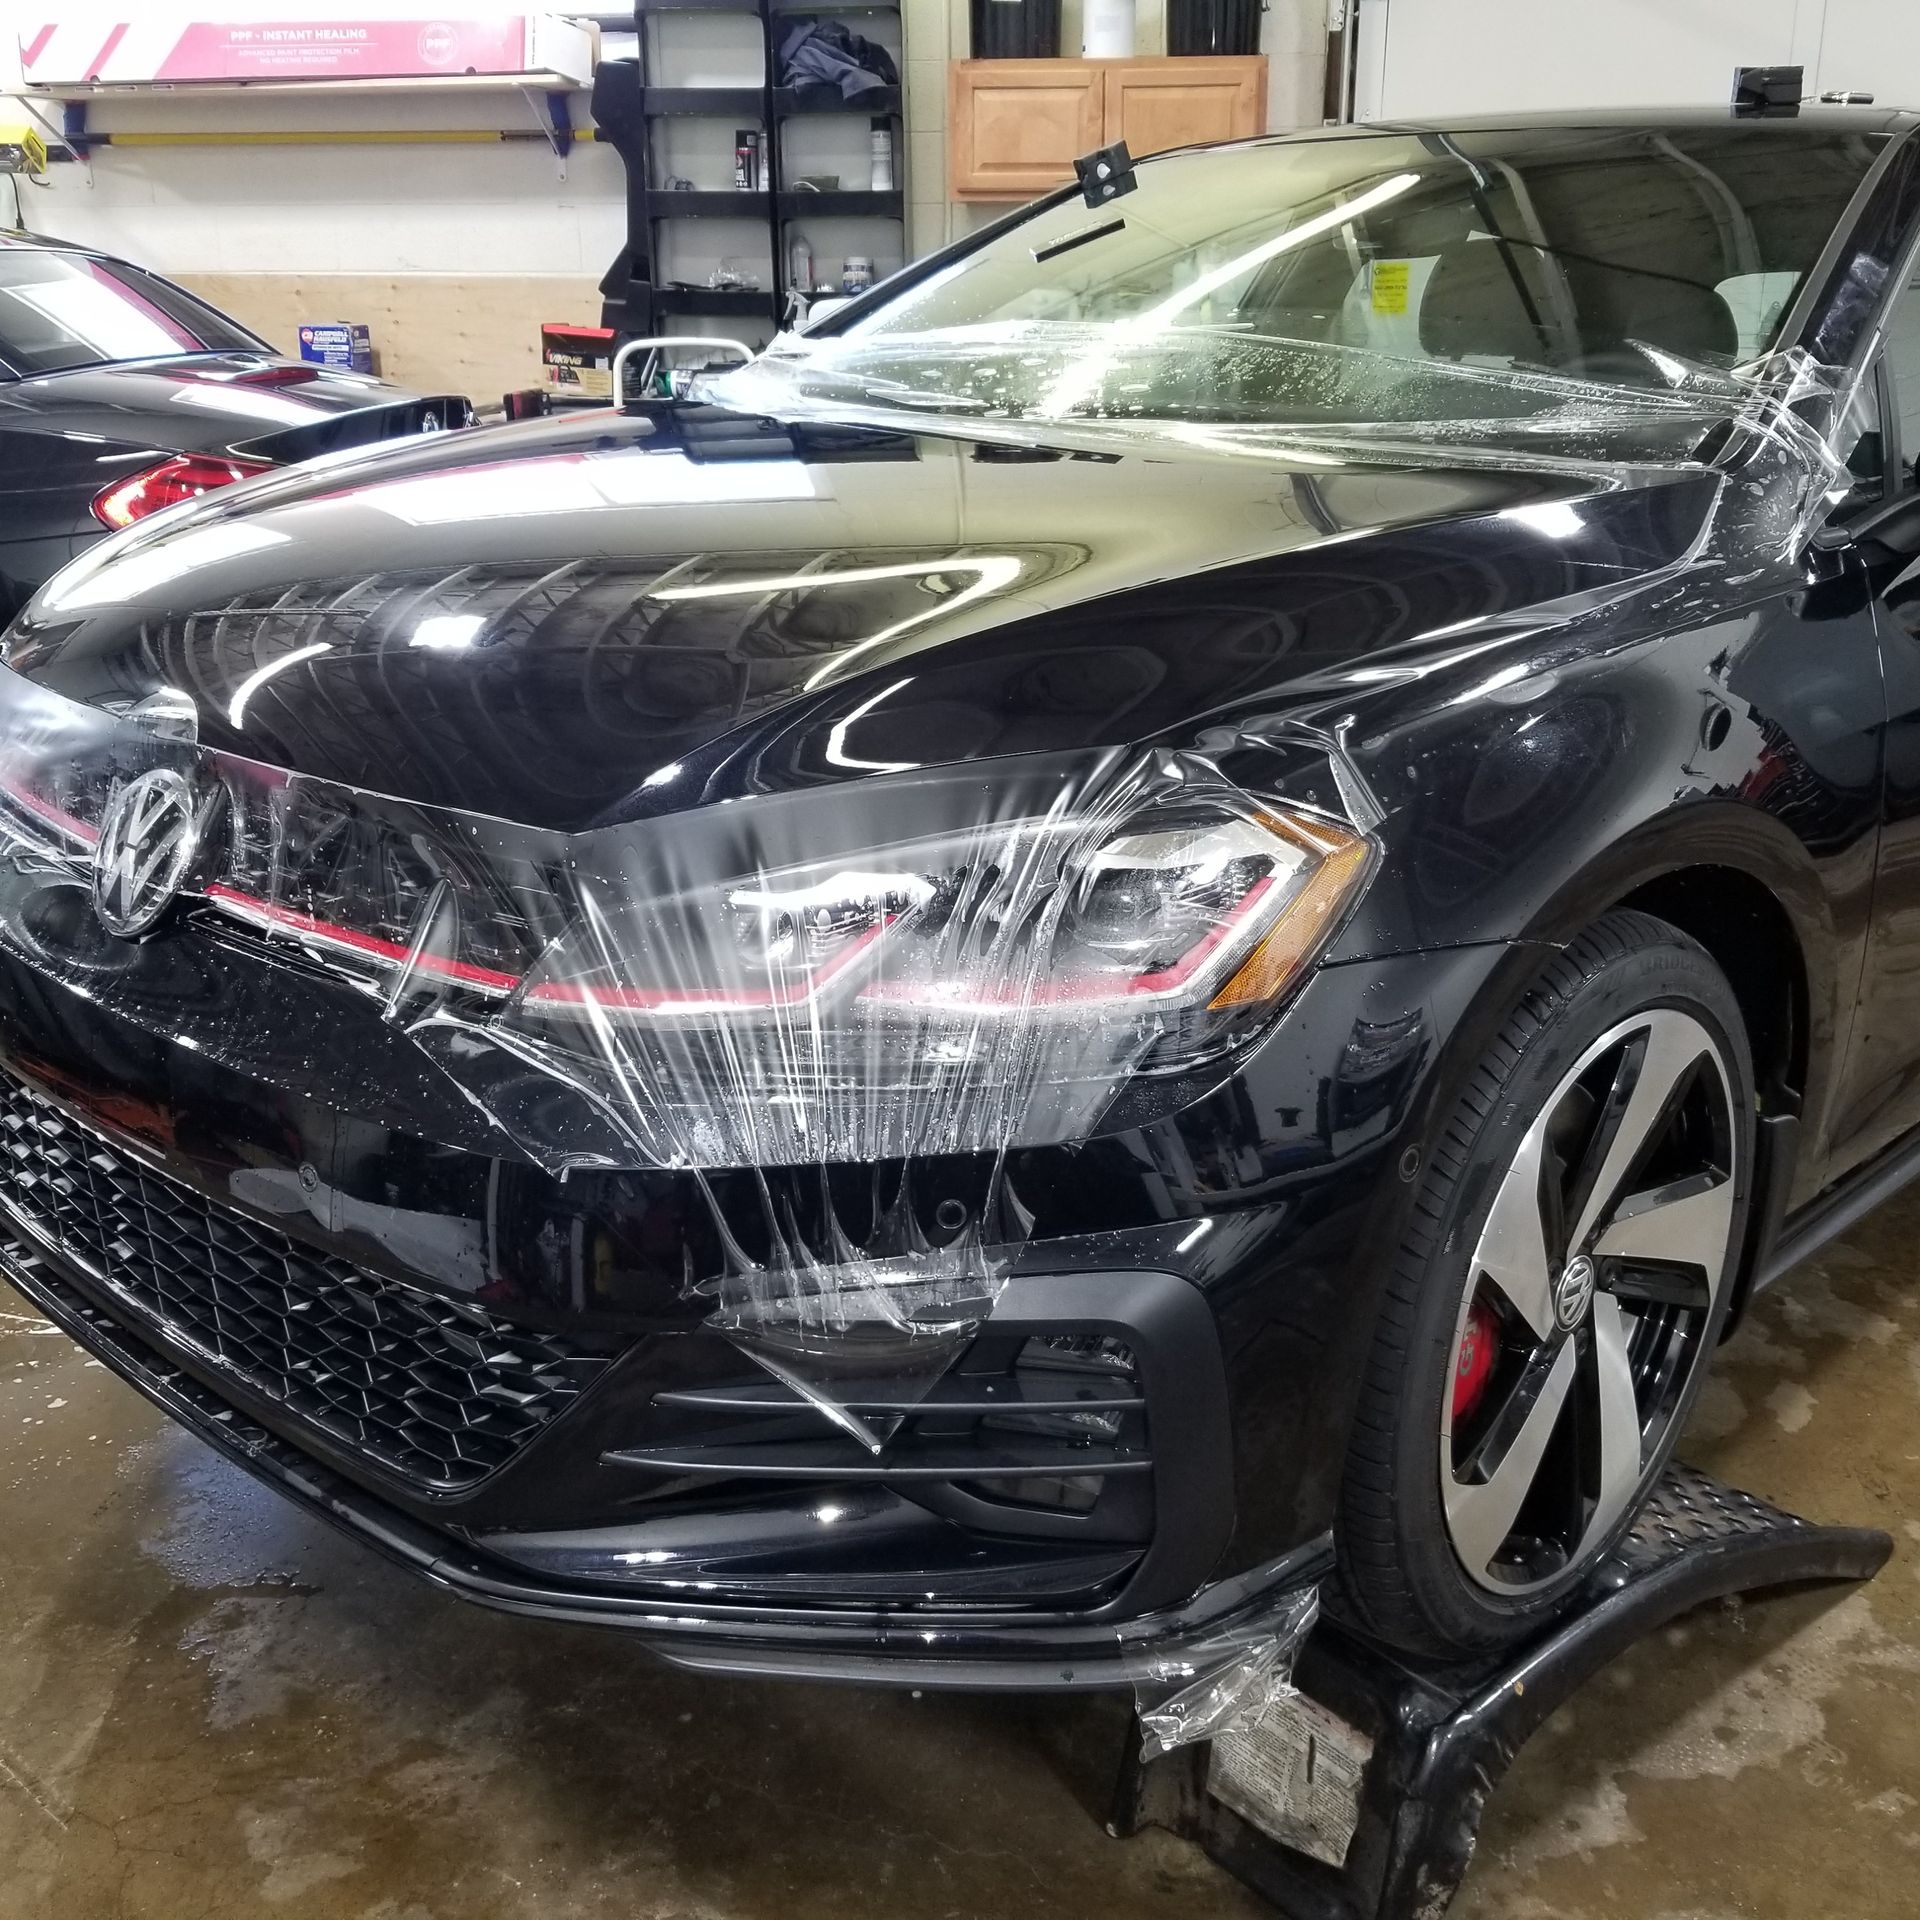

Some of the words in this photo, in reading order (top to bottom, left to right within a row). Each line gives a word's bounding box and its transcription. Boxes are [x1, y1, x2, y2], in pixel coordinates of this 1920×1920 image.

[230, 31, 253, 41] PPF
[262, 30, 313, 41] INSTANT
[315, 28, 368, 40] HEALING
[549, 353, 583, 365] VIKING
